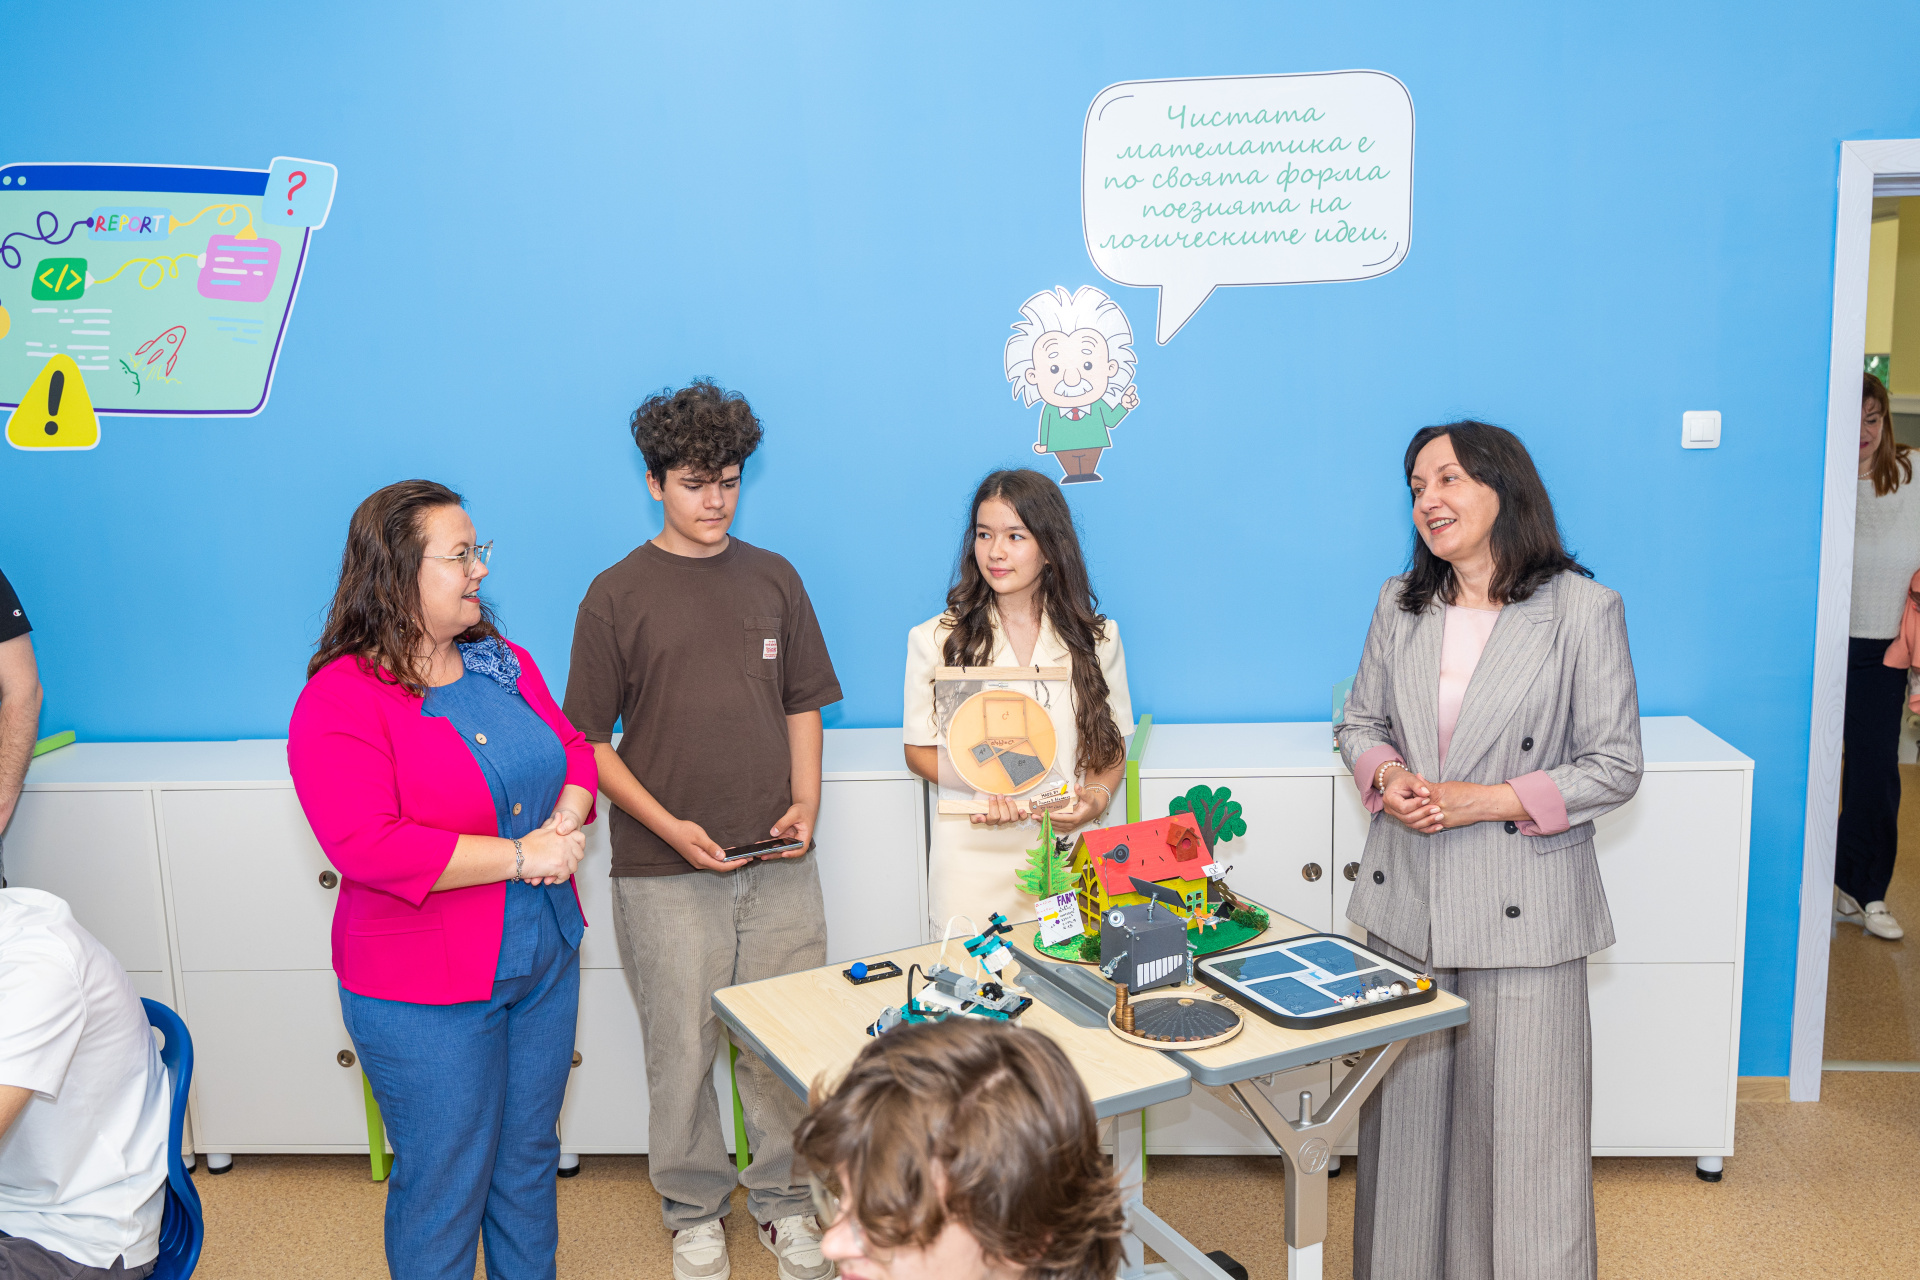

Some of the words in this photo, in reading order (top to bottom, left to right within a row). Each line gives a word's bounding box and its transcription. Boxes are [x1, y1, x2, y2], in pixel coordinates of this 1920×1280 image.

[1167, 104, 1327, 130] Чистата
[1116, 136, 1352, 159] математика
[1357, 136, 1376, 154] е
[1104, 173, 1145, 190] по
[1152, 165, 1270, 190] своята
[1276, 161, 1392, 193] форма
[1142, 197, 1301, 224] поезията
[1309, 196, 1352, 215] на
[94, 214, 165, 234] REPORT
[1099, 227, 1307, 250] логическите
[1313, 219, 1389, 243] идеи.
[1056, 891, 1077, 907] FARM
